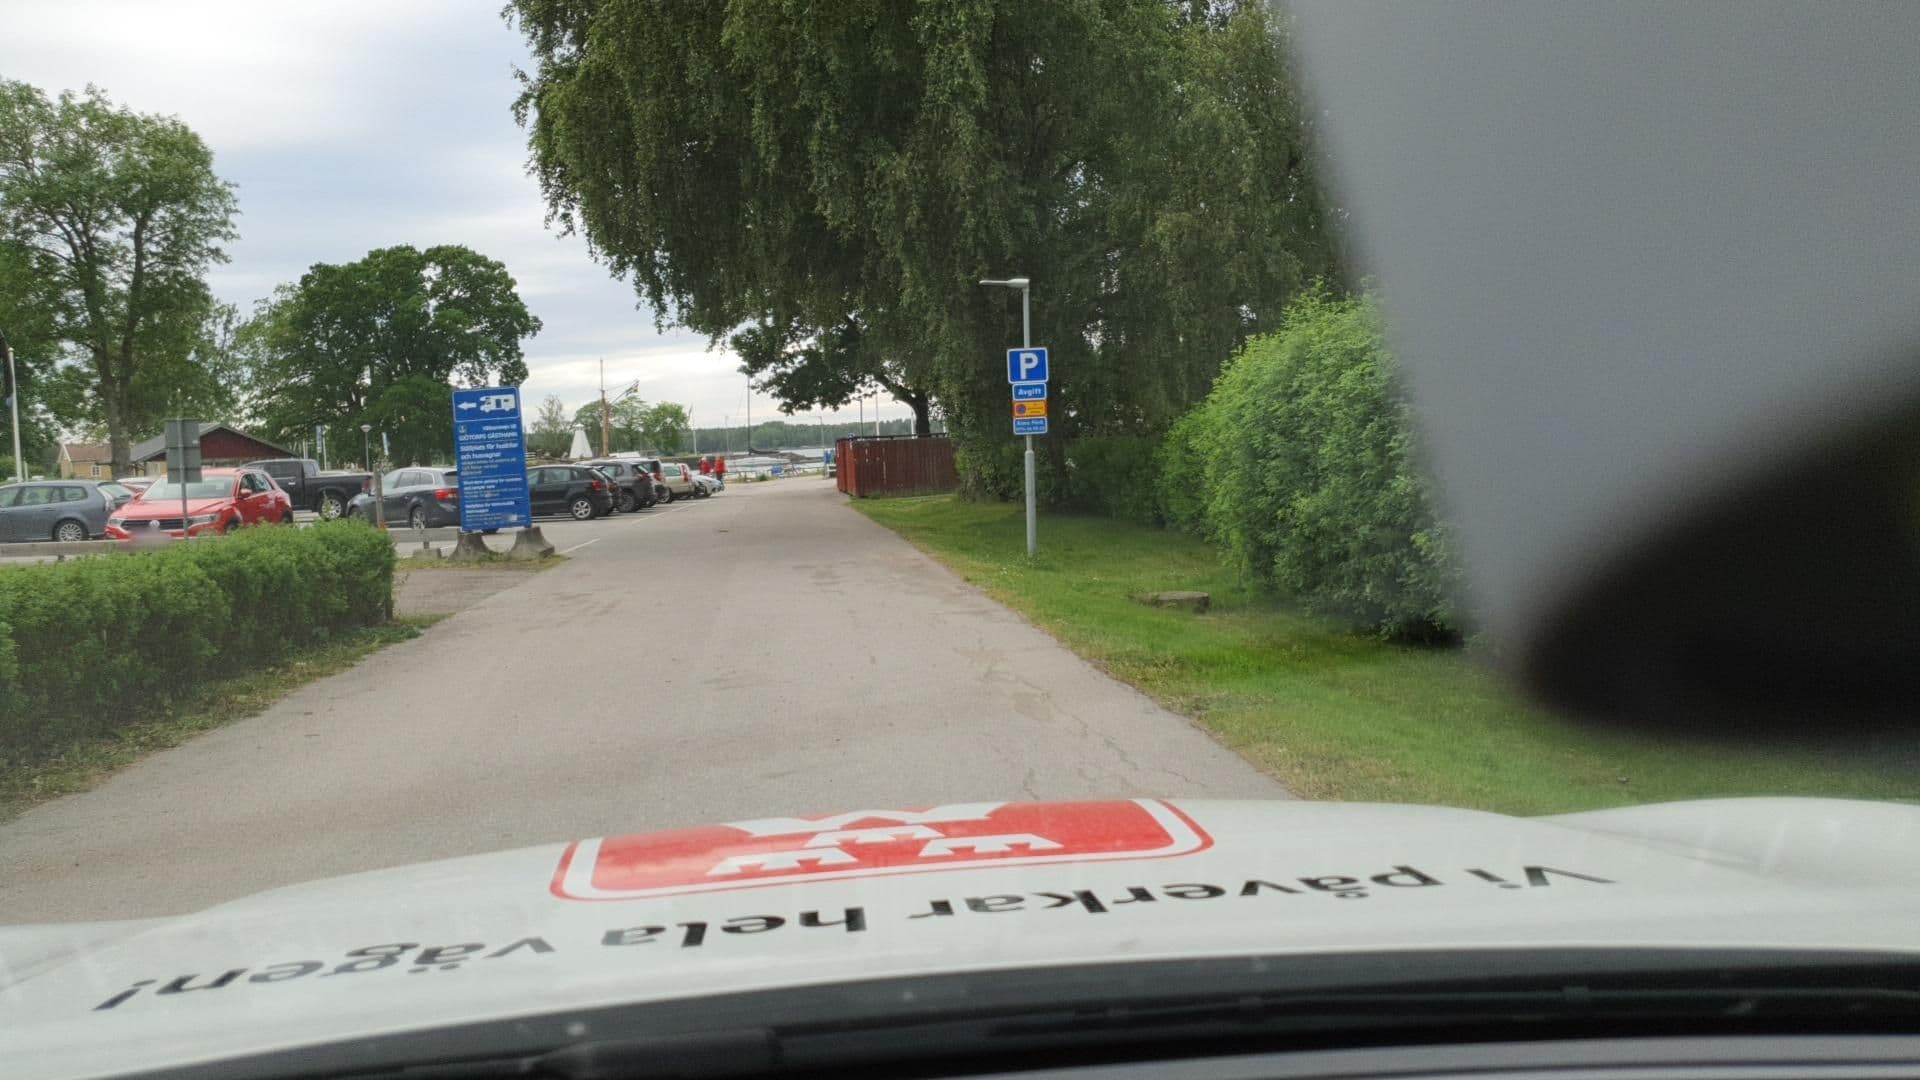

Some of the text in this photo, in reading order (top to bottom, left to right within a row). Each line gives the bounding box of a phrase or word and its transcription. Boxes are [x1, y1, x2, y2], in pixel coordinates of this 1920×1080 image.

[1019, 352, 1039, 380] P
[1018, 387, 1042, 397] Avgift
[91, 864, 1618, 1011] Vi påverkar hela vägen!
